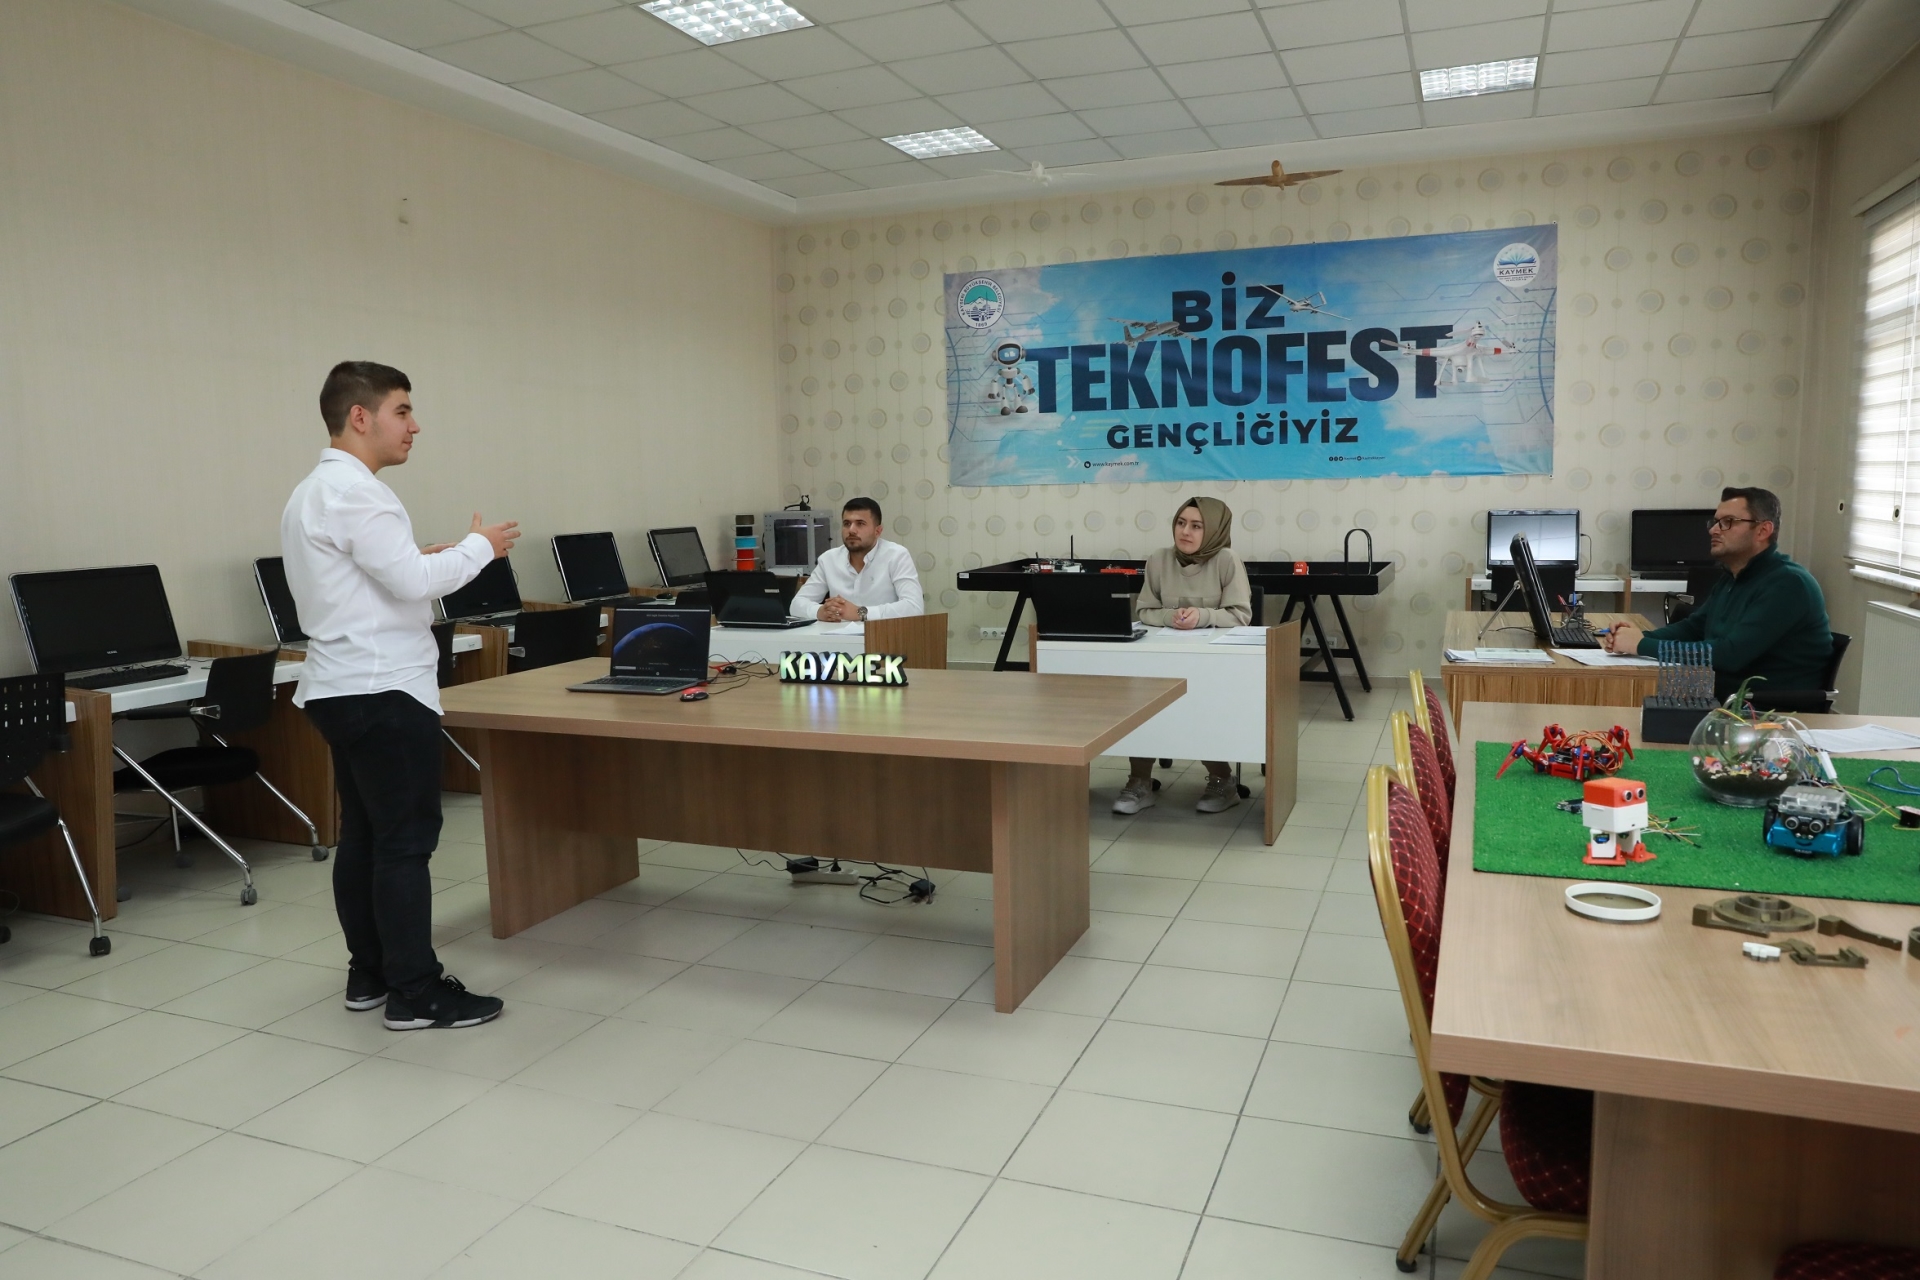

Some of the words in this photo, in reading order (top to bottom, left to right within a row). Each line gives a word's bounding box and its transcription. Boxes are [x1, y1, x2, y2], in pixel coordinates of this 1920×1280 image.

[1172, 271, 1285, 332] BİZ
[1025, 325, 1453, 413] TEKNOFEST
[1106, 408, 1359, 455] GENÇLİĞİYİZ
[1092, 460, 1139, 468] www.kaymek.com.tr
[780, 651, 904, 684] KAYMEK
